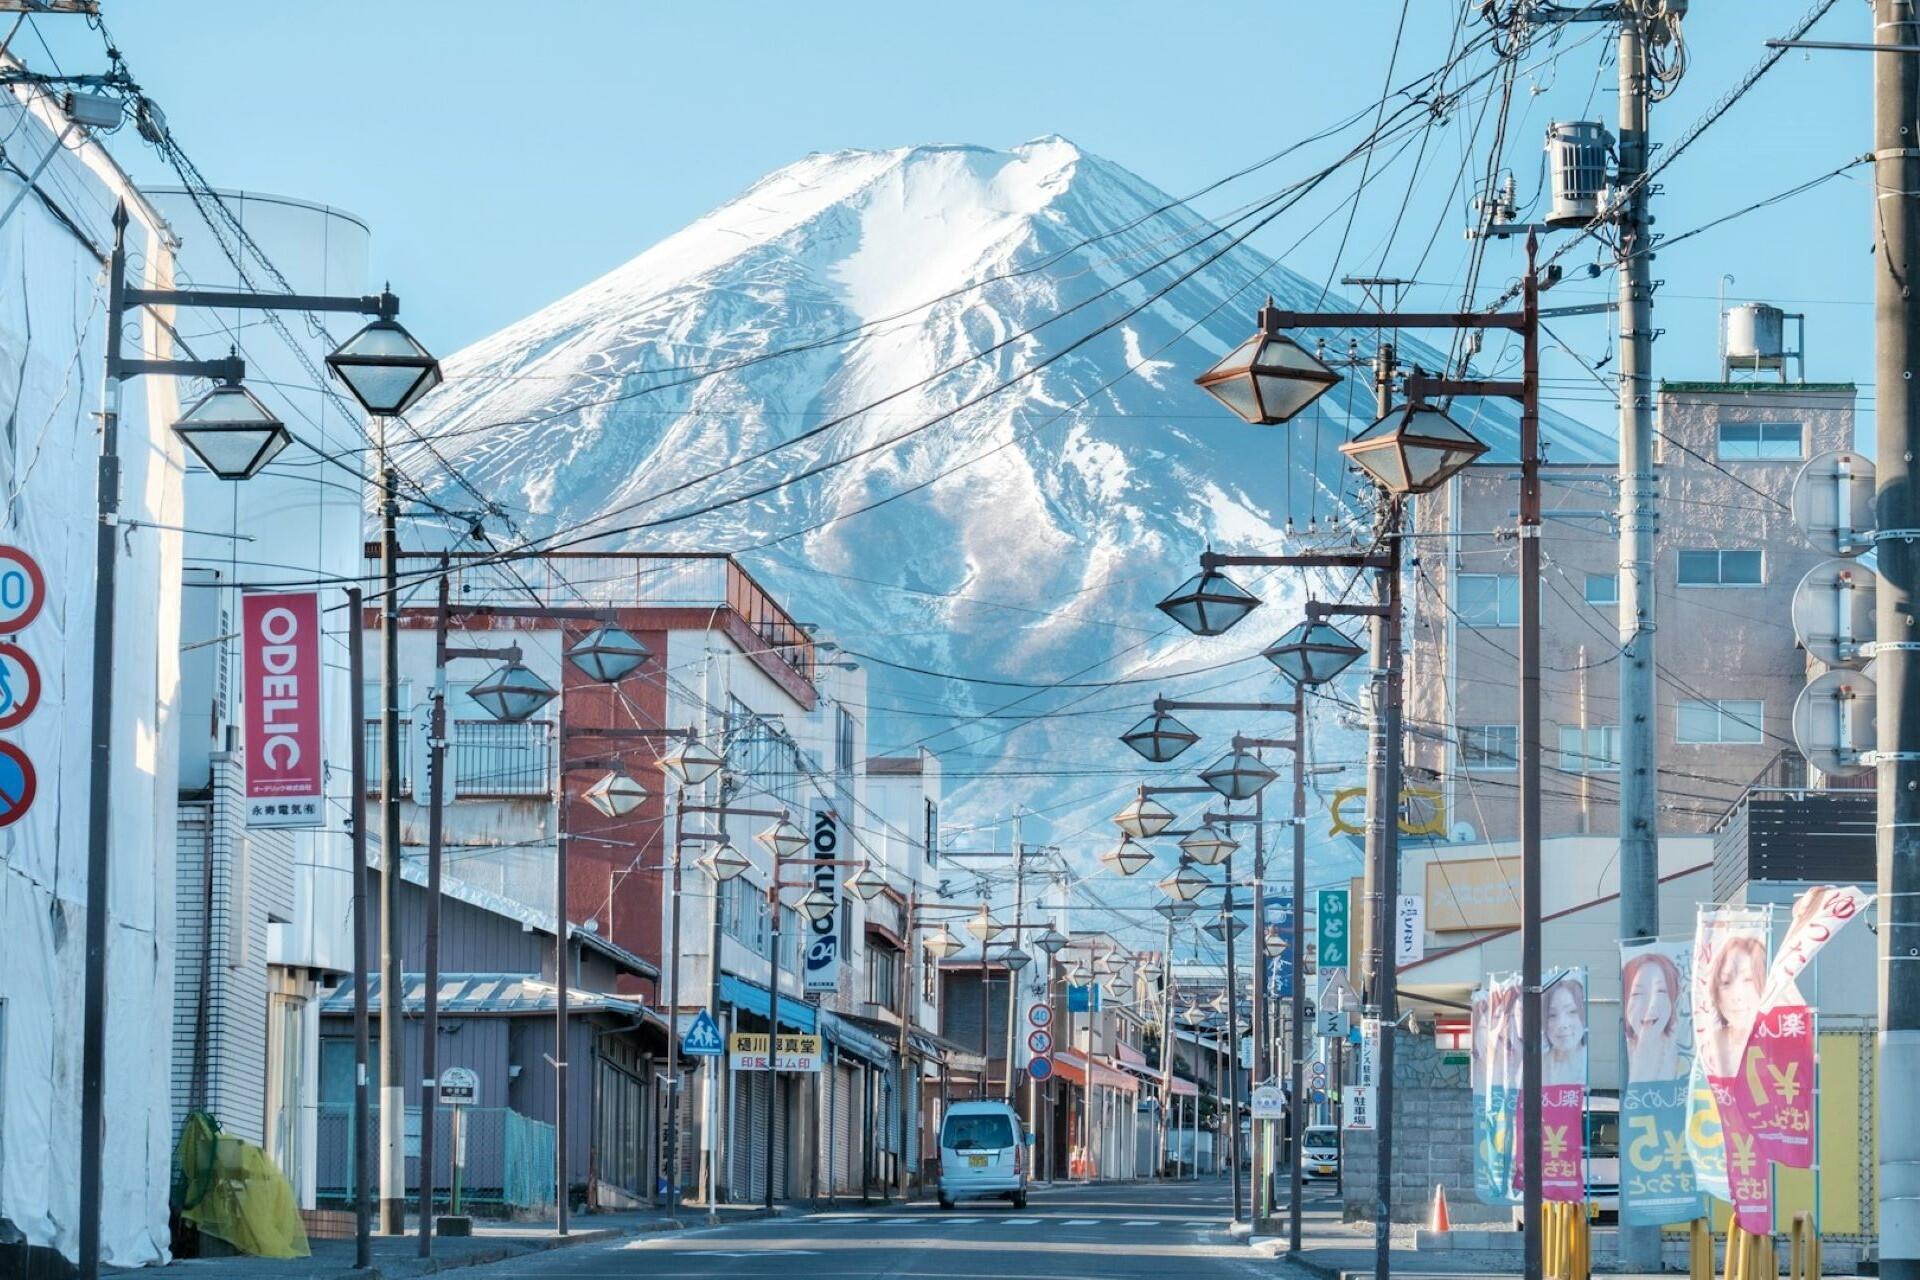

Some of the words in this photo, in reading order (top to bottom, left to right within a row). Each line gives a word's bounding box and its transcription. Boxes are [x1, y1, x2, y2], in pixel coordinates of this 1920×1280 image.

[2, 571, 24, 609] 0
[261, 607, 300, 770] ODELIC
[812, 810, 837, 934] KOKUO
[1324, 894, 1344, 962] ふとん
[1033, 1010, 1047, 1021] 40
